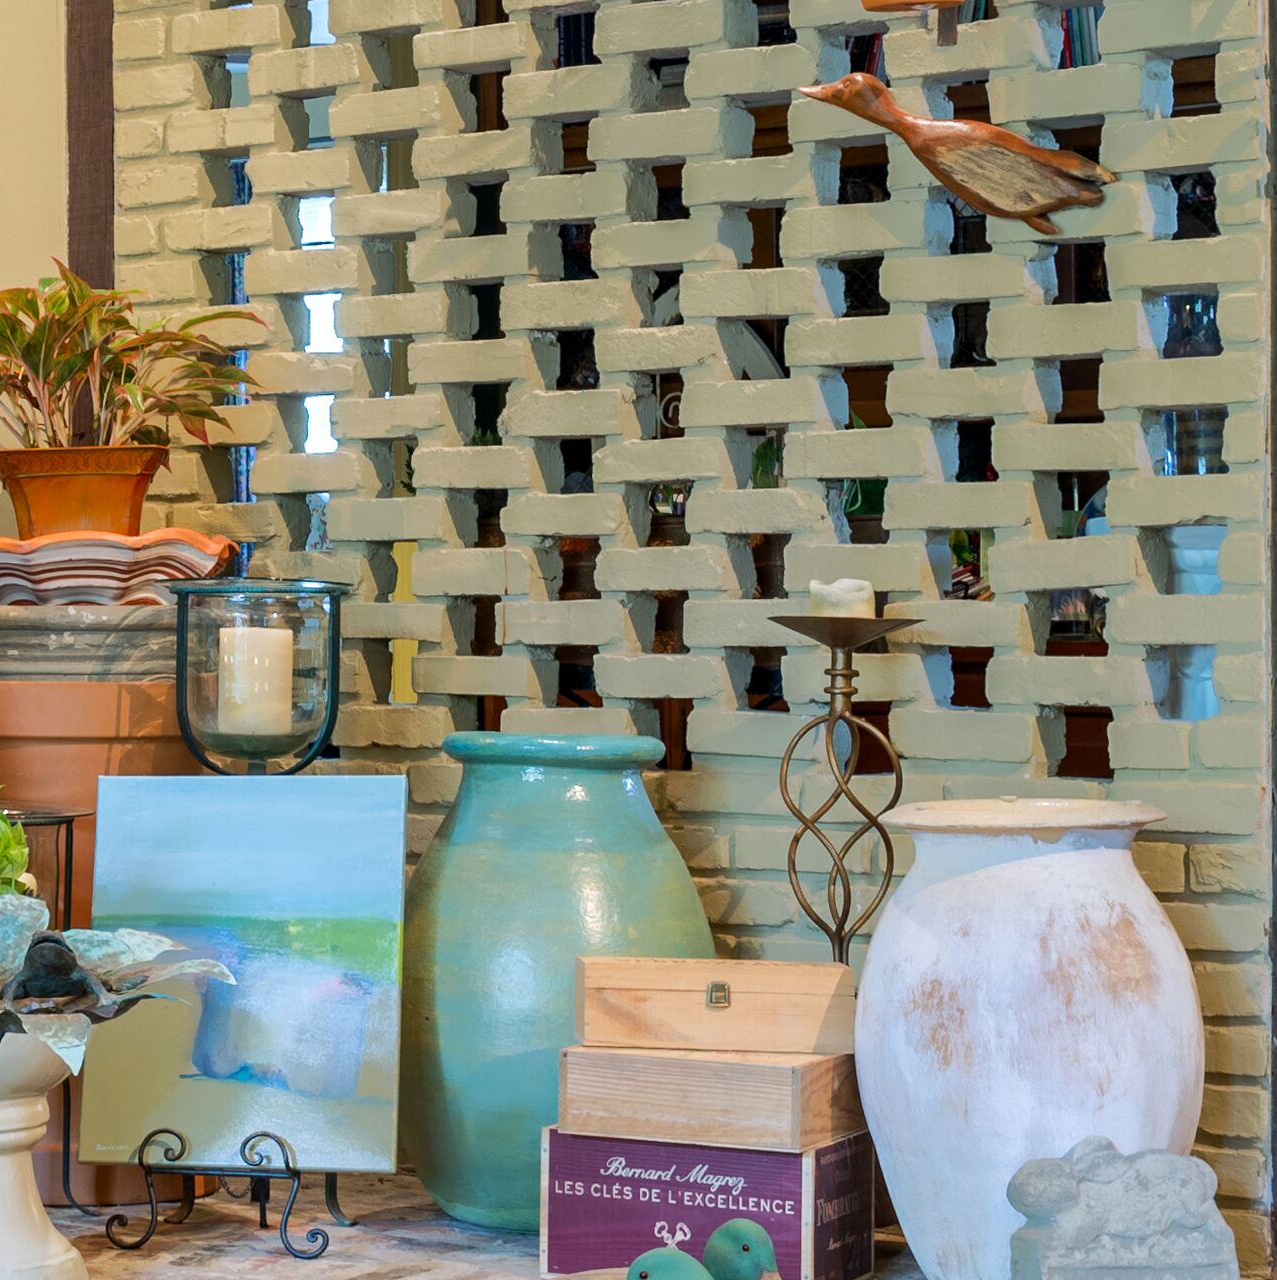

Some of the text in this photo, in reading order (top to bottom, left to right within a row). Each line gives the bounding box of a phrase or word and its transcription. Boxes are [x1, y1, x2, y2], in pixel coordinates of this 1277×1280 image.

[600, 1156, 748, 1196] Bernard Magrez
[554, 1180, 795, 1215] LES CLÉS DE L'EXCELLENCE
